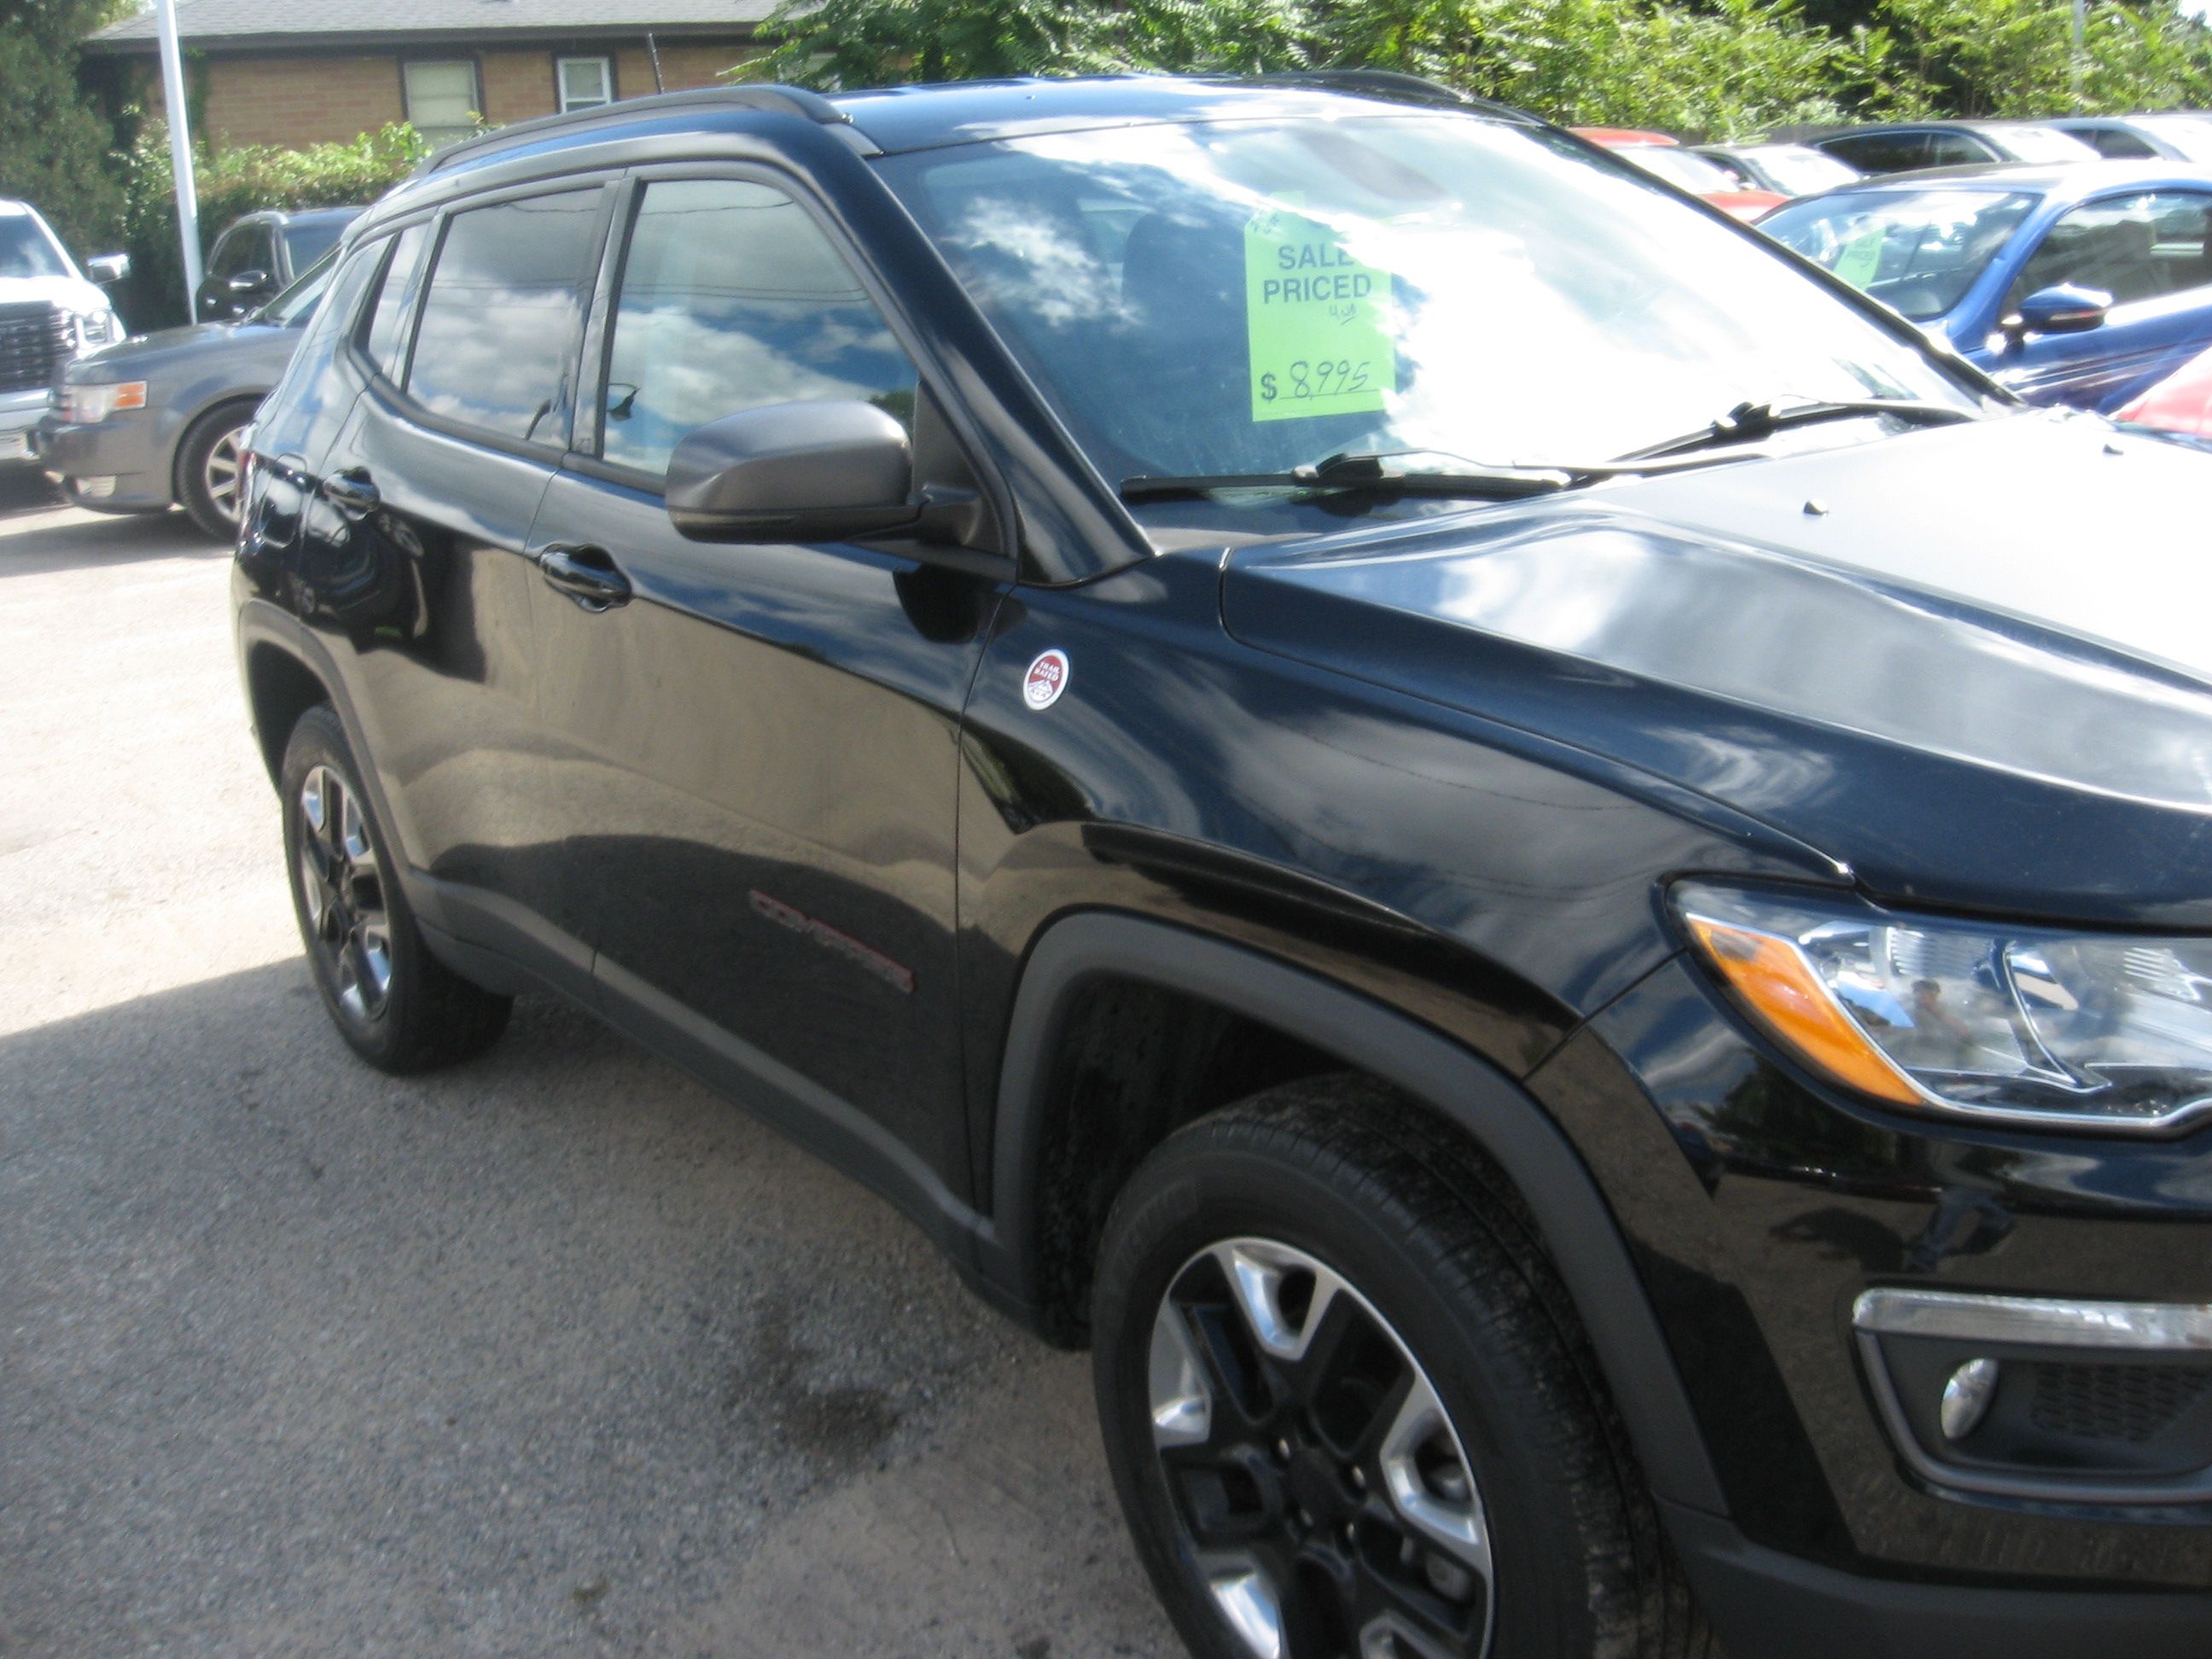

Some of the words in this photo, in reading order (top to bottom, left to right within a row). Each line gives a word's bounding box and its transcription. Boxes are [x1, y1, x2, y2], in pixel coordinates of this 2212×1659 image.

[1278, 243, 1355, 270] SALE
[1263, 273, 1372, 304] PRICED
[1260, 371, 1278, 403] $
